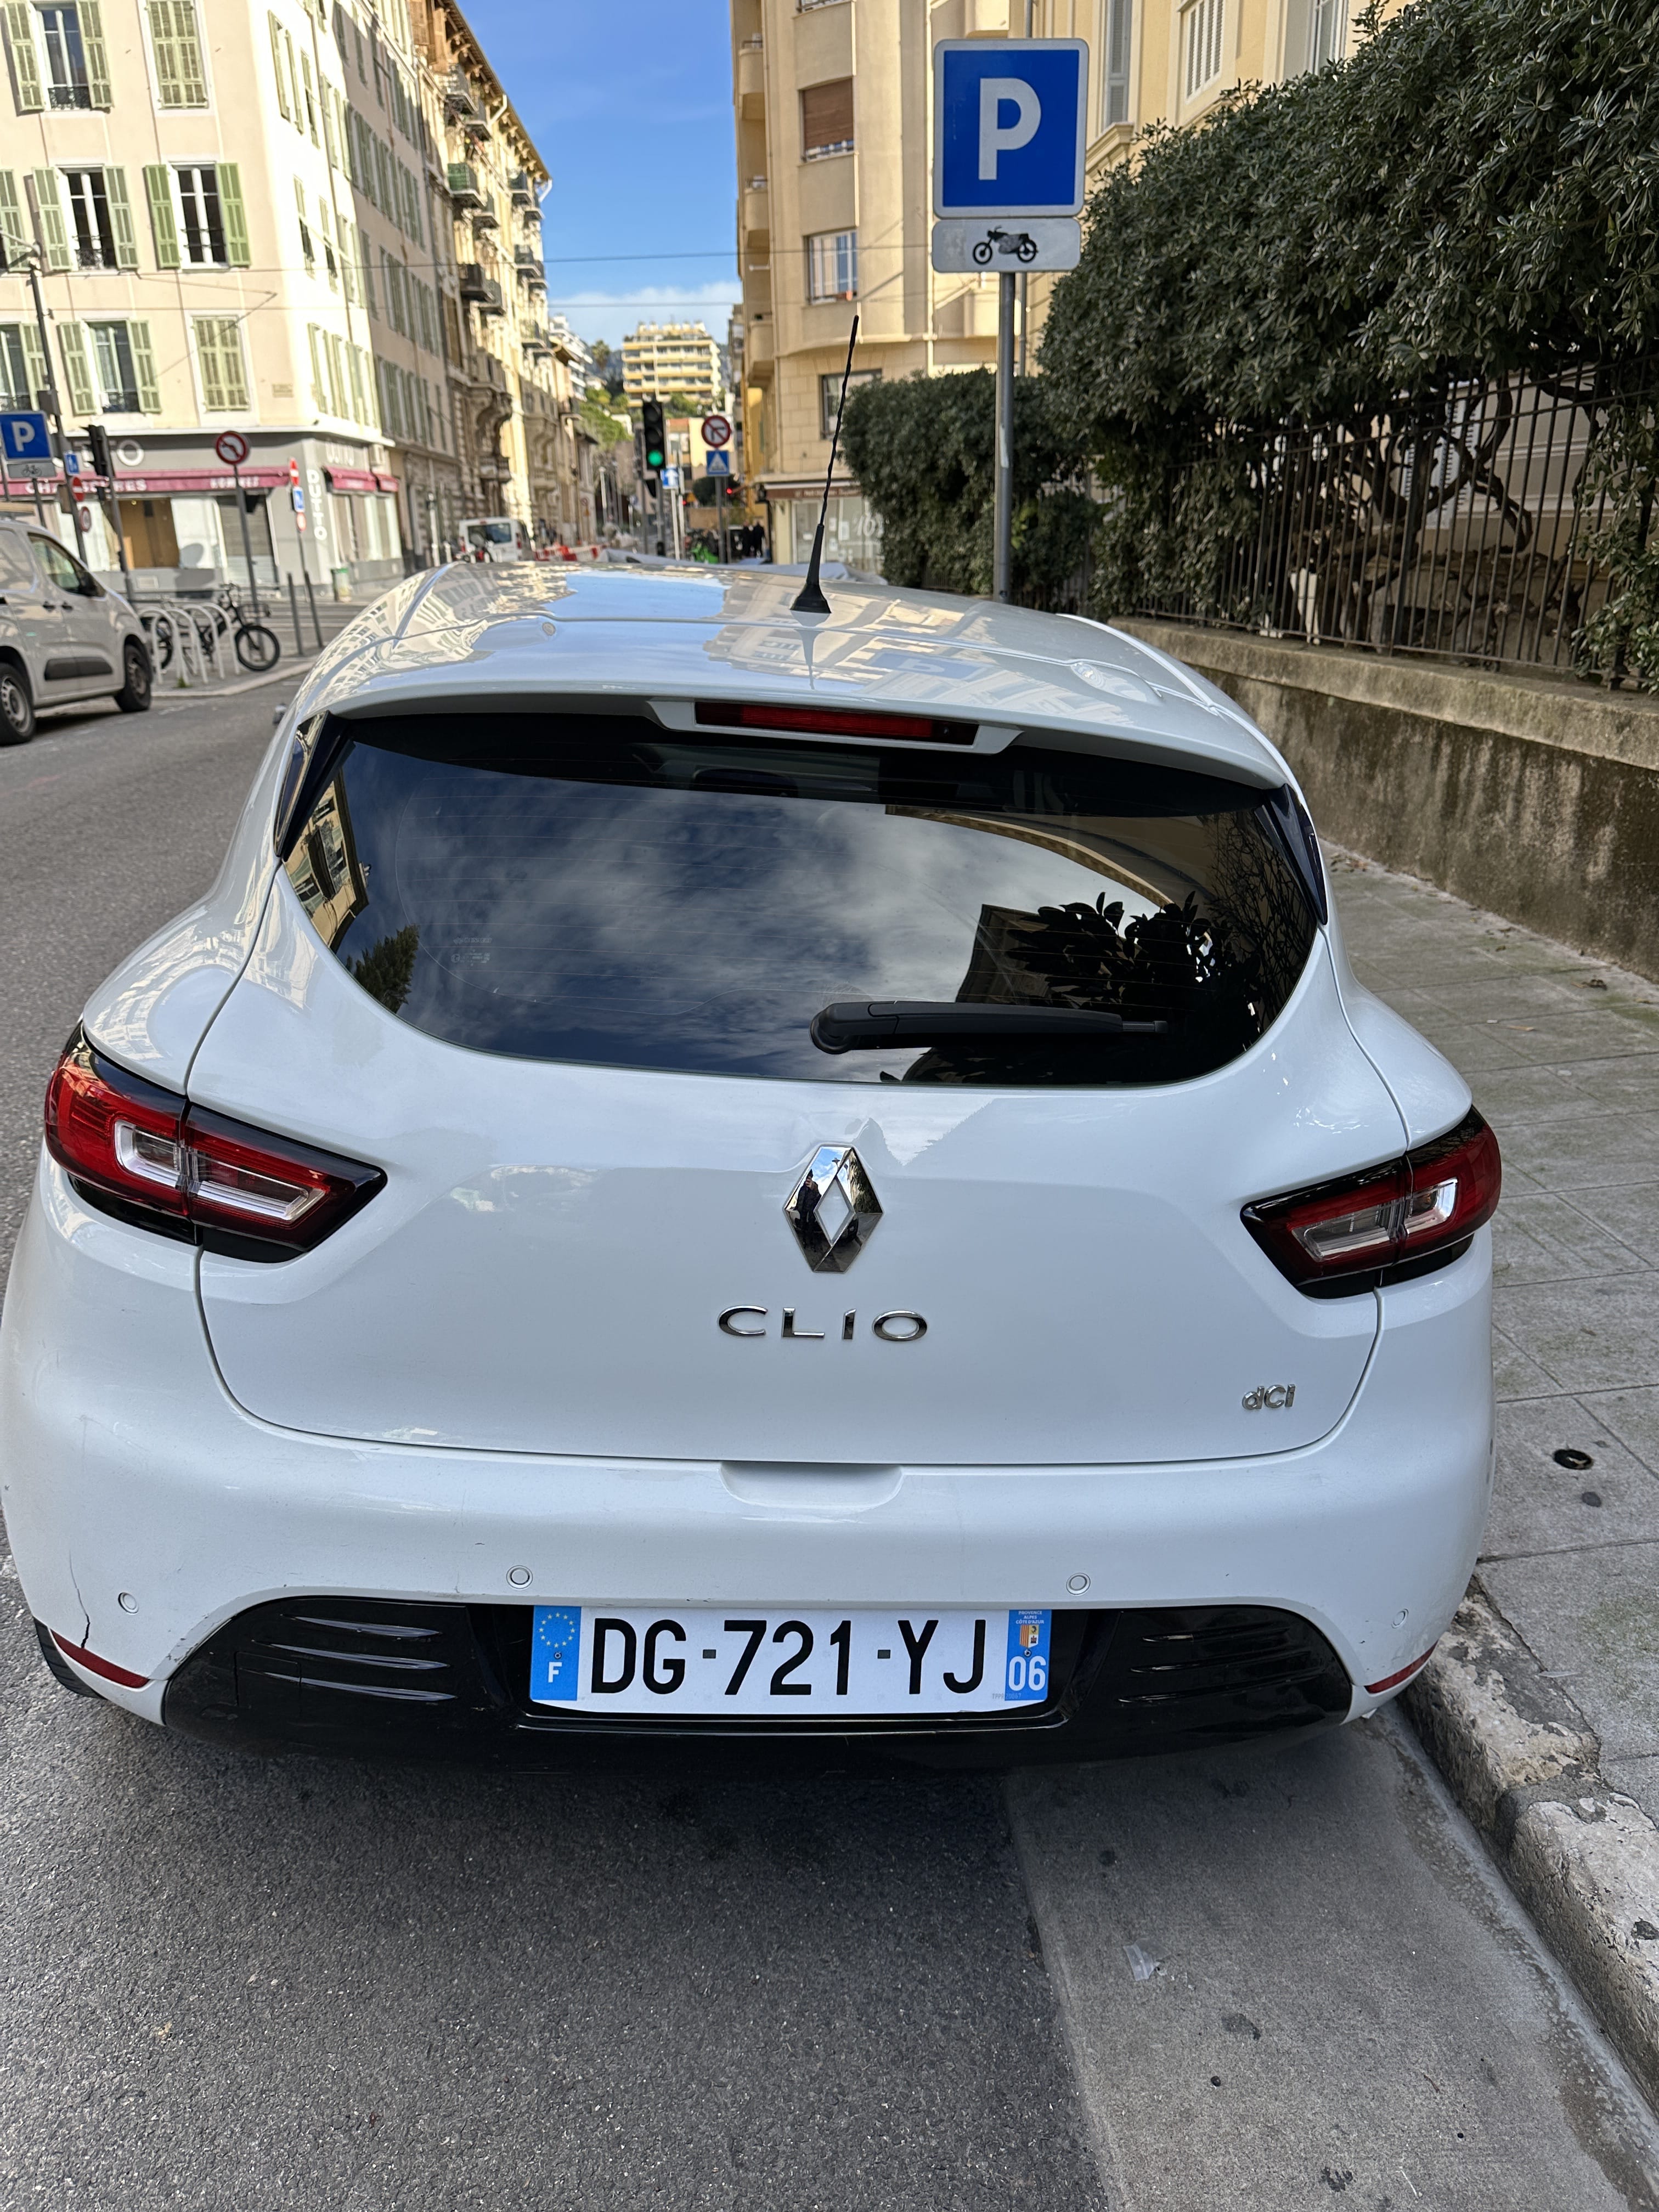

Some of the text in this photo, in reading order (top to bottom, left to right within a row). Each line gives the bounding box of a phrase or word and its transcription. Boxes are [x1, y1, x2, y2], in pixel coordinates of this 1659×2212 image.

[978, 77, 1041, 180] P
[11, 421, 36, 452] P
[306, 469, 328, 540] DUTTO
[717, 1304, 928, 1342] CLIO
[548, 1662, 562, 1683] F
[1008, 1655, 1046, 1691] 06
